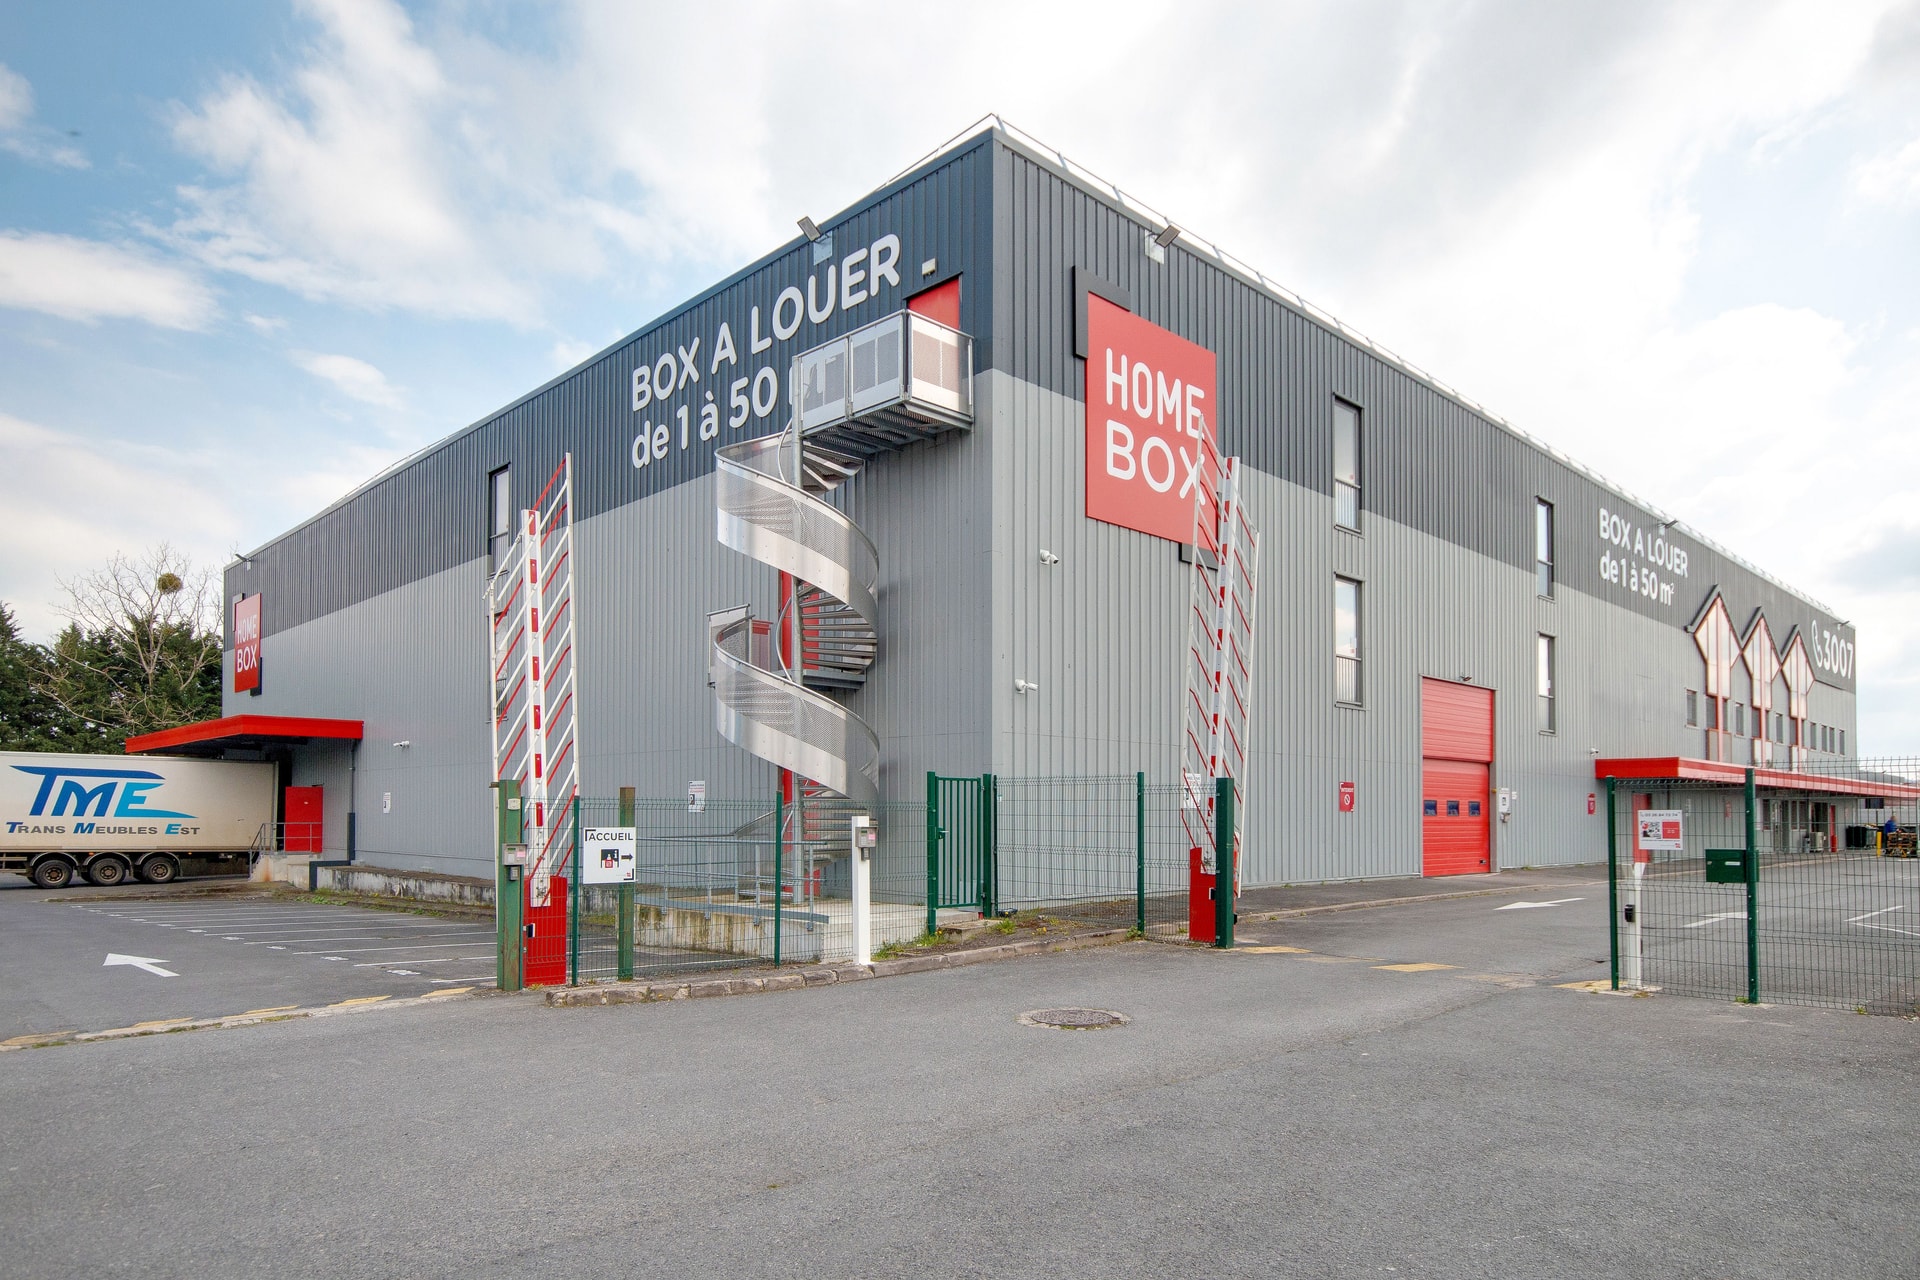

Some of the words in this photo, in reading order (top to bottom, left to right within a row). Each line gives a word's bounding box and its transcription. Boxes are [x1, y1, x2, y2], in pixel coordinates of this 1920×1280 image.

[632, 336, 700, 411] BOX
[711, 322, 737, 374] A
[751, 233, 900, 354] LOUER
[632, 420, 670, 469] de
[676, 404, 688, 450] 1
[700, 390, 719, 441] à
[729, 366, 778, 428] 50
[1106, 347, 1205, 440] HOME
[1106, 419, 1206, 505] BOX
[1599, 507, 1631, 551] BOX
[1634, 527, 1645, 558] A
[1647, 532, 1688, 578] LOUER
[1600, 549, 1619, 584] de
[1620, 558, 1627, 588] 1
[1630, 561, 1639, 592] à
[1641, 567, 1659, 600] 50
[237, 614, 258, 645] HOME
[1823, 630, 1854, 679] 3007
[237, 643, 258, 673] BOX
[8, 765, 199, 818] TME
[5, 821, 66, 834] TRANS
[72, 822, 158, 835] MEUBLES
[588, 832, 634, 841] ACCUEIL
